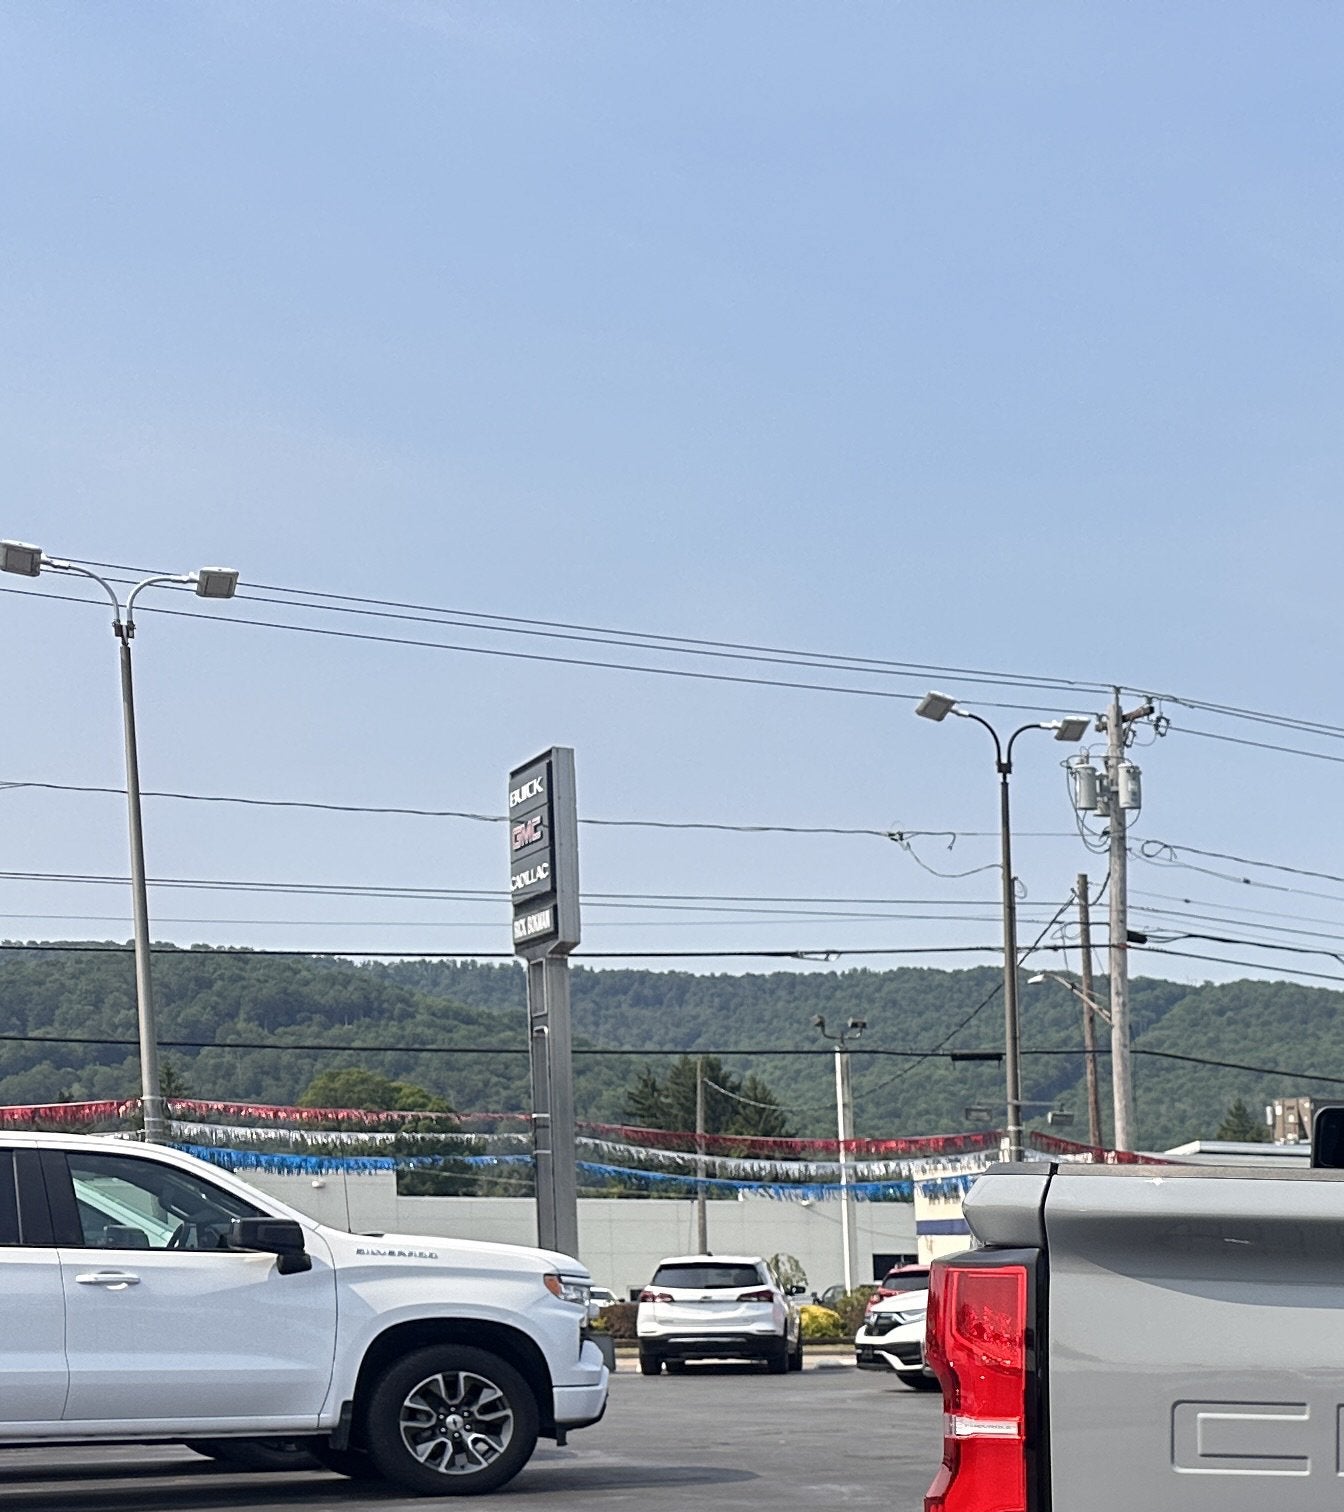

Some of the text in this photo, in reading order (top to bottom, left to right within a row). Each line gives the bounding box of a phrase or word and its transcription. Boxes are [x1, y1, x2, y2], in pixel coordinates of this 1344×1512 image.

[510, 776, 543, 808] BUICK
[512, 816, 542, 850] GMC
[510, 863, 549, 891] CADILLAC
